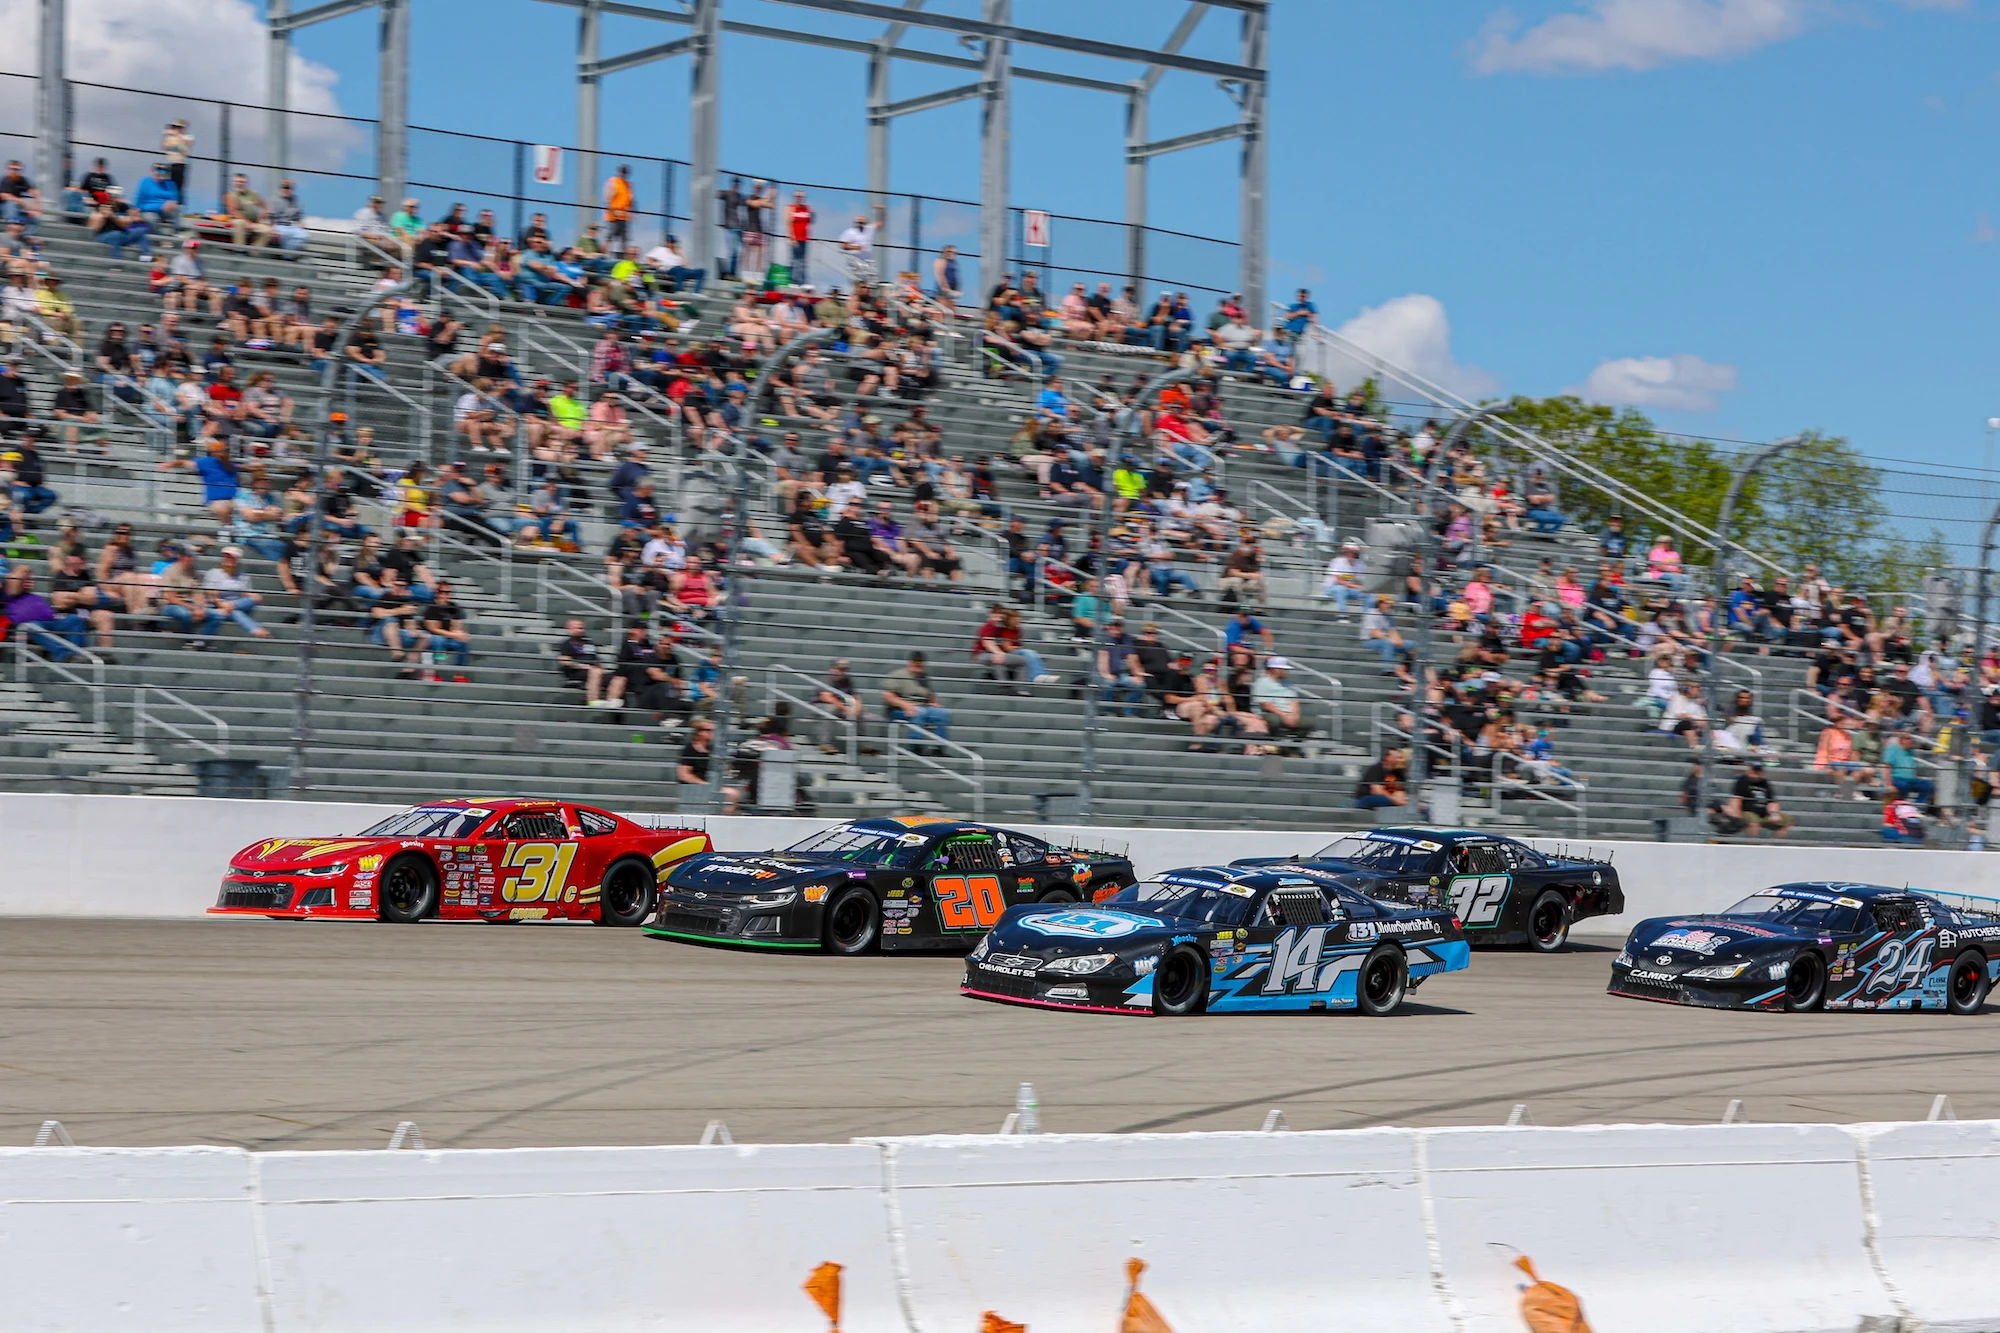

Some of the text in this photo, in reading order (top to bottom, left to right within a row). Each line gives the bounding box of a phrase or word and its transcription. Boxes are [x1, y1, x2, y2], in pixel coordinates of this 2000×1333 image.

[933, 876, 1007, 929] 20
[1349, 922, 1376, 938] 131
[979, 962, 1036, 977] CHEVROLET SS
[1262, 926, 1334, 994] 14
[1630, 969, 1679, 981] CAMRY
[1867, 939, 1936, 993] 24
